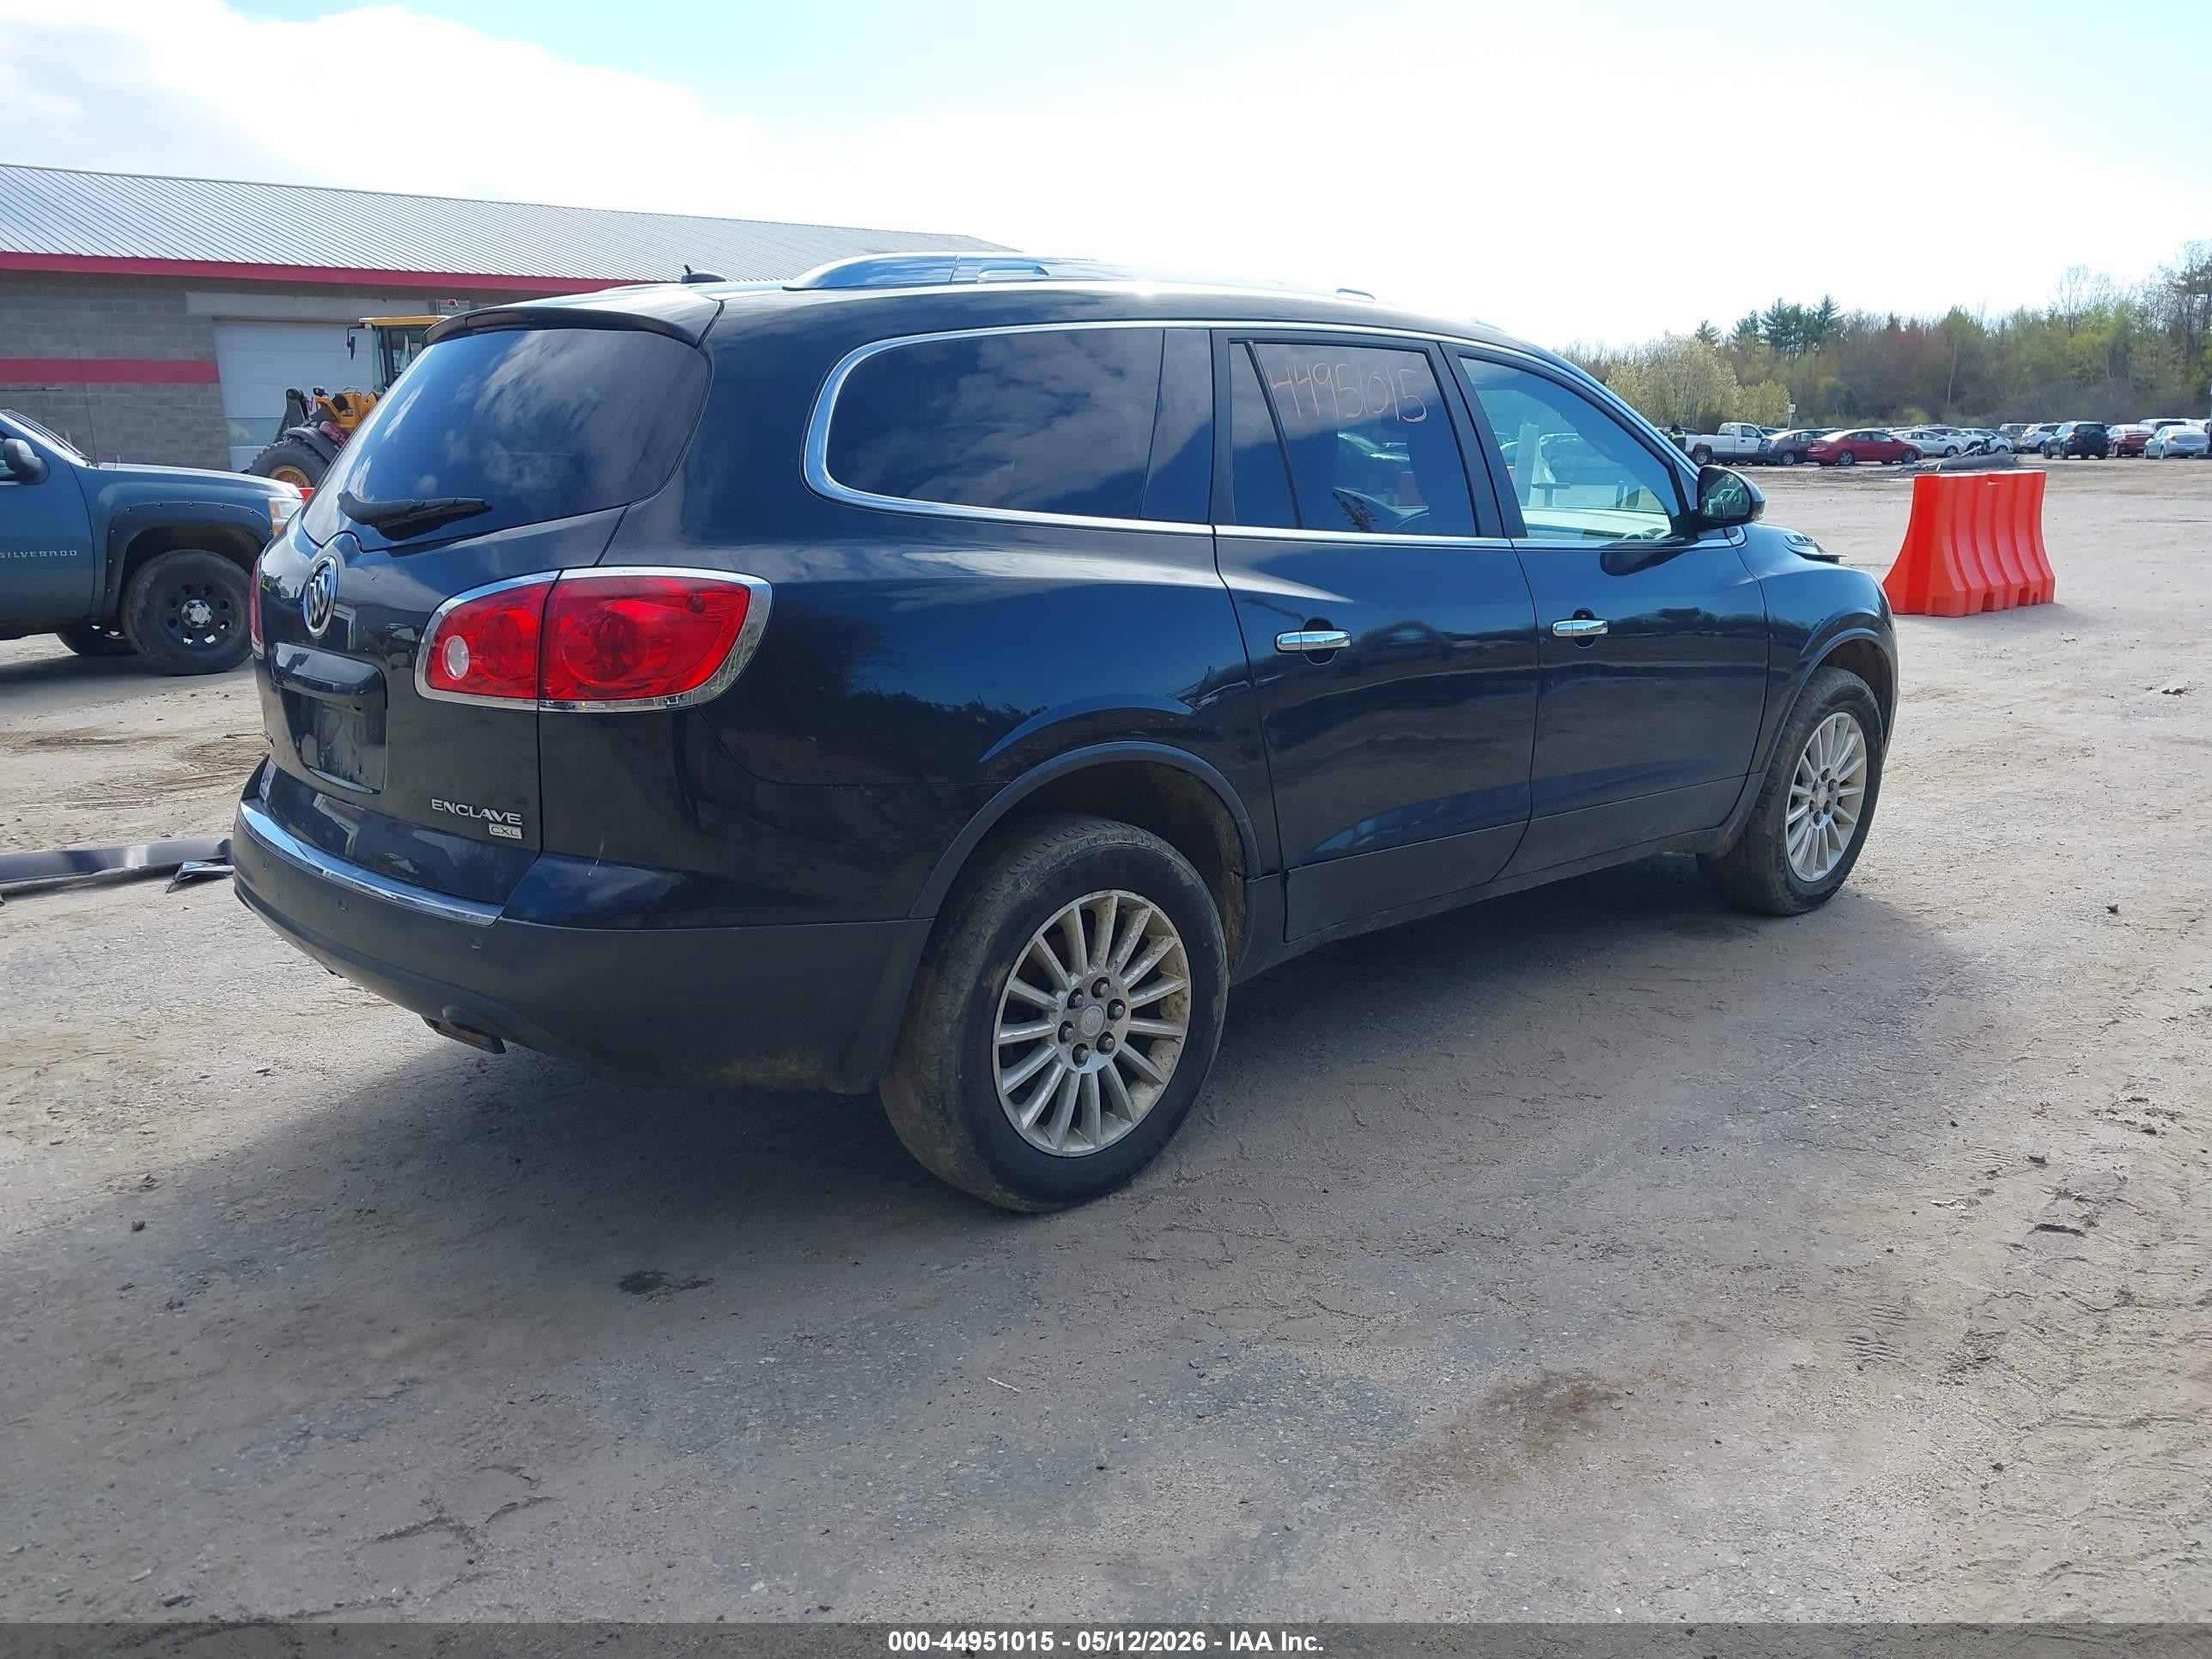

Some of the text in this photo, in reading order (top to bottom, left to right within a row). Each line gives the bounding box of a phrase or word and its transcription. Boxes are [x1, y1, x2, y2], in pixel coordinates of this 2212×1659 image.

[1266, 362, 1428, 423] 44951015
[0, 550, 77, 558] SILVERADO
[431, 798, 523, 826] ENCLAVE
[489, 825, 520, 838] CXL
